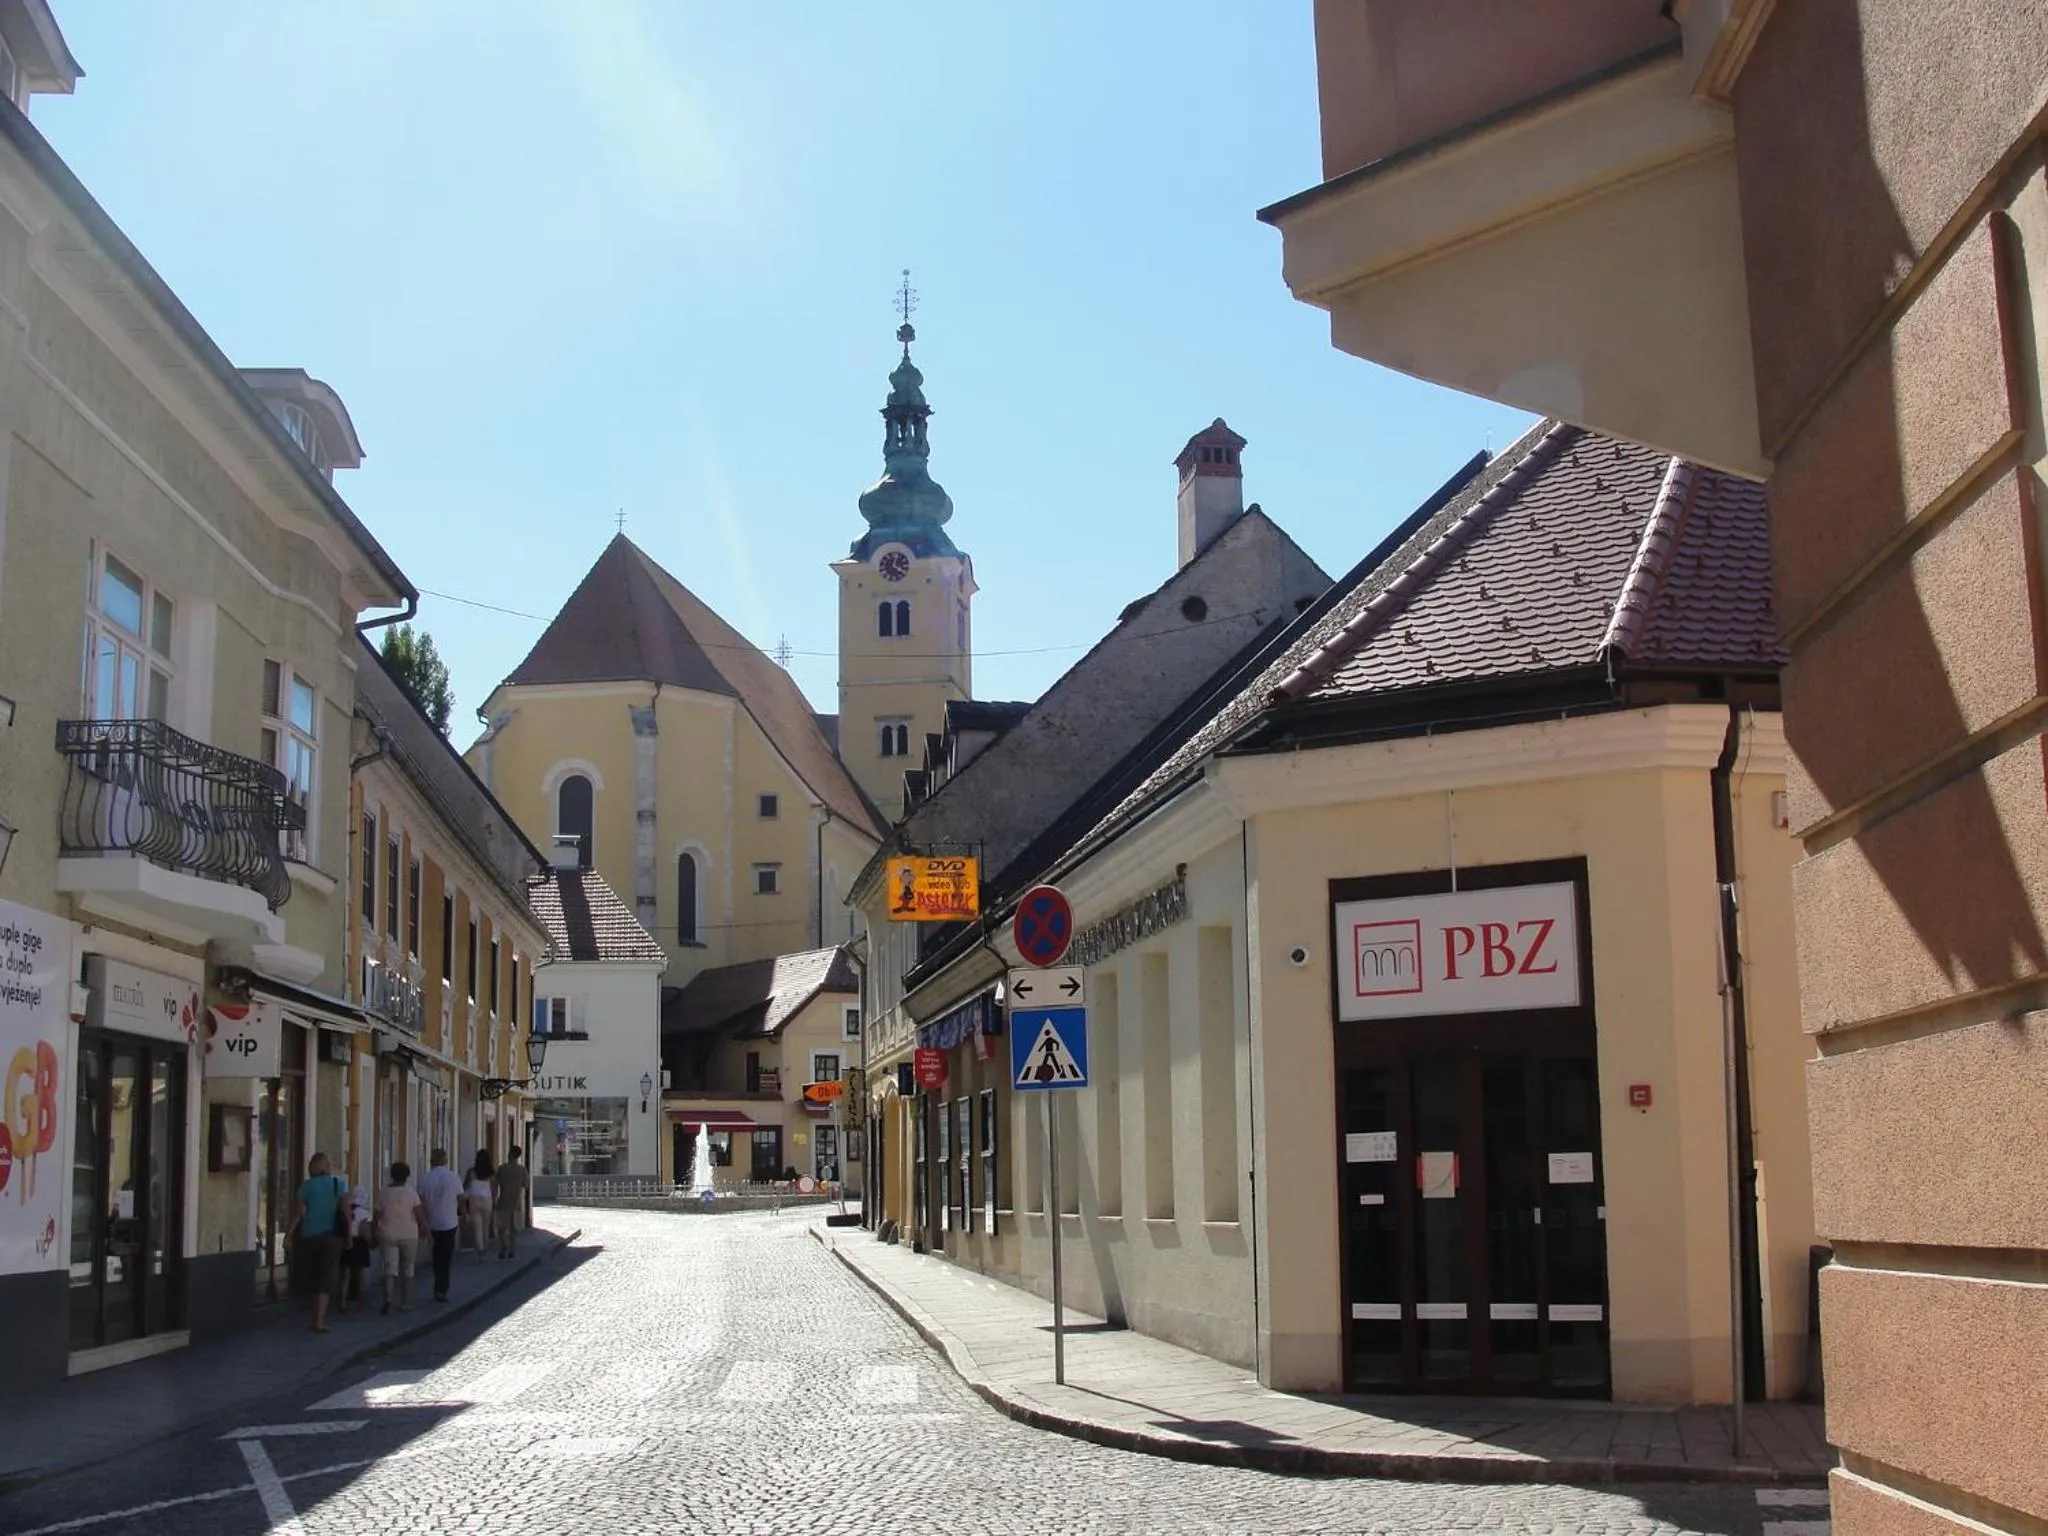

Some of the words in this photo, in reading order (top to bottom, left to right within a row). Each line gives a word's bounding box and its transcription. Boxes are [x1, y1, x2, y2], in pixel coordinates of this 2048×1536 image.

[927, 860, 966, 871] DVD
[928, 878, 951, 890] video
[23, 927, 42, 953] gige
[1440, 918, 1558, 981] PBZ
[6, 951, 32, 979] duplo
[163, 992, 177, 1022] vip
[225, 1033, 258, 1057] vip
[5, 1039, 59, 1160] GB
[35, 1231, 49, 1259] vip
